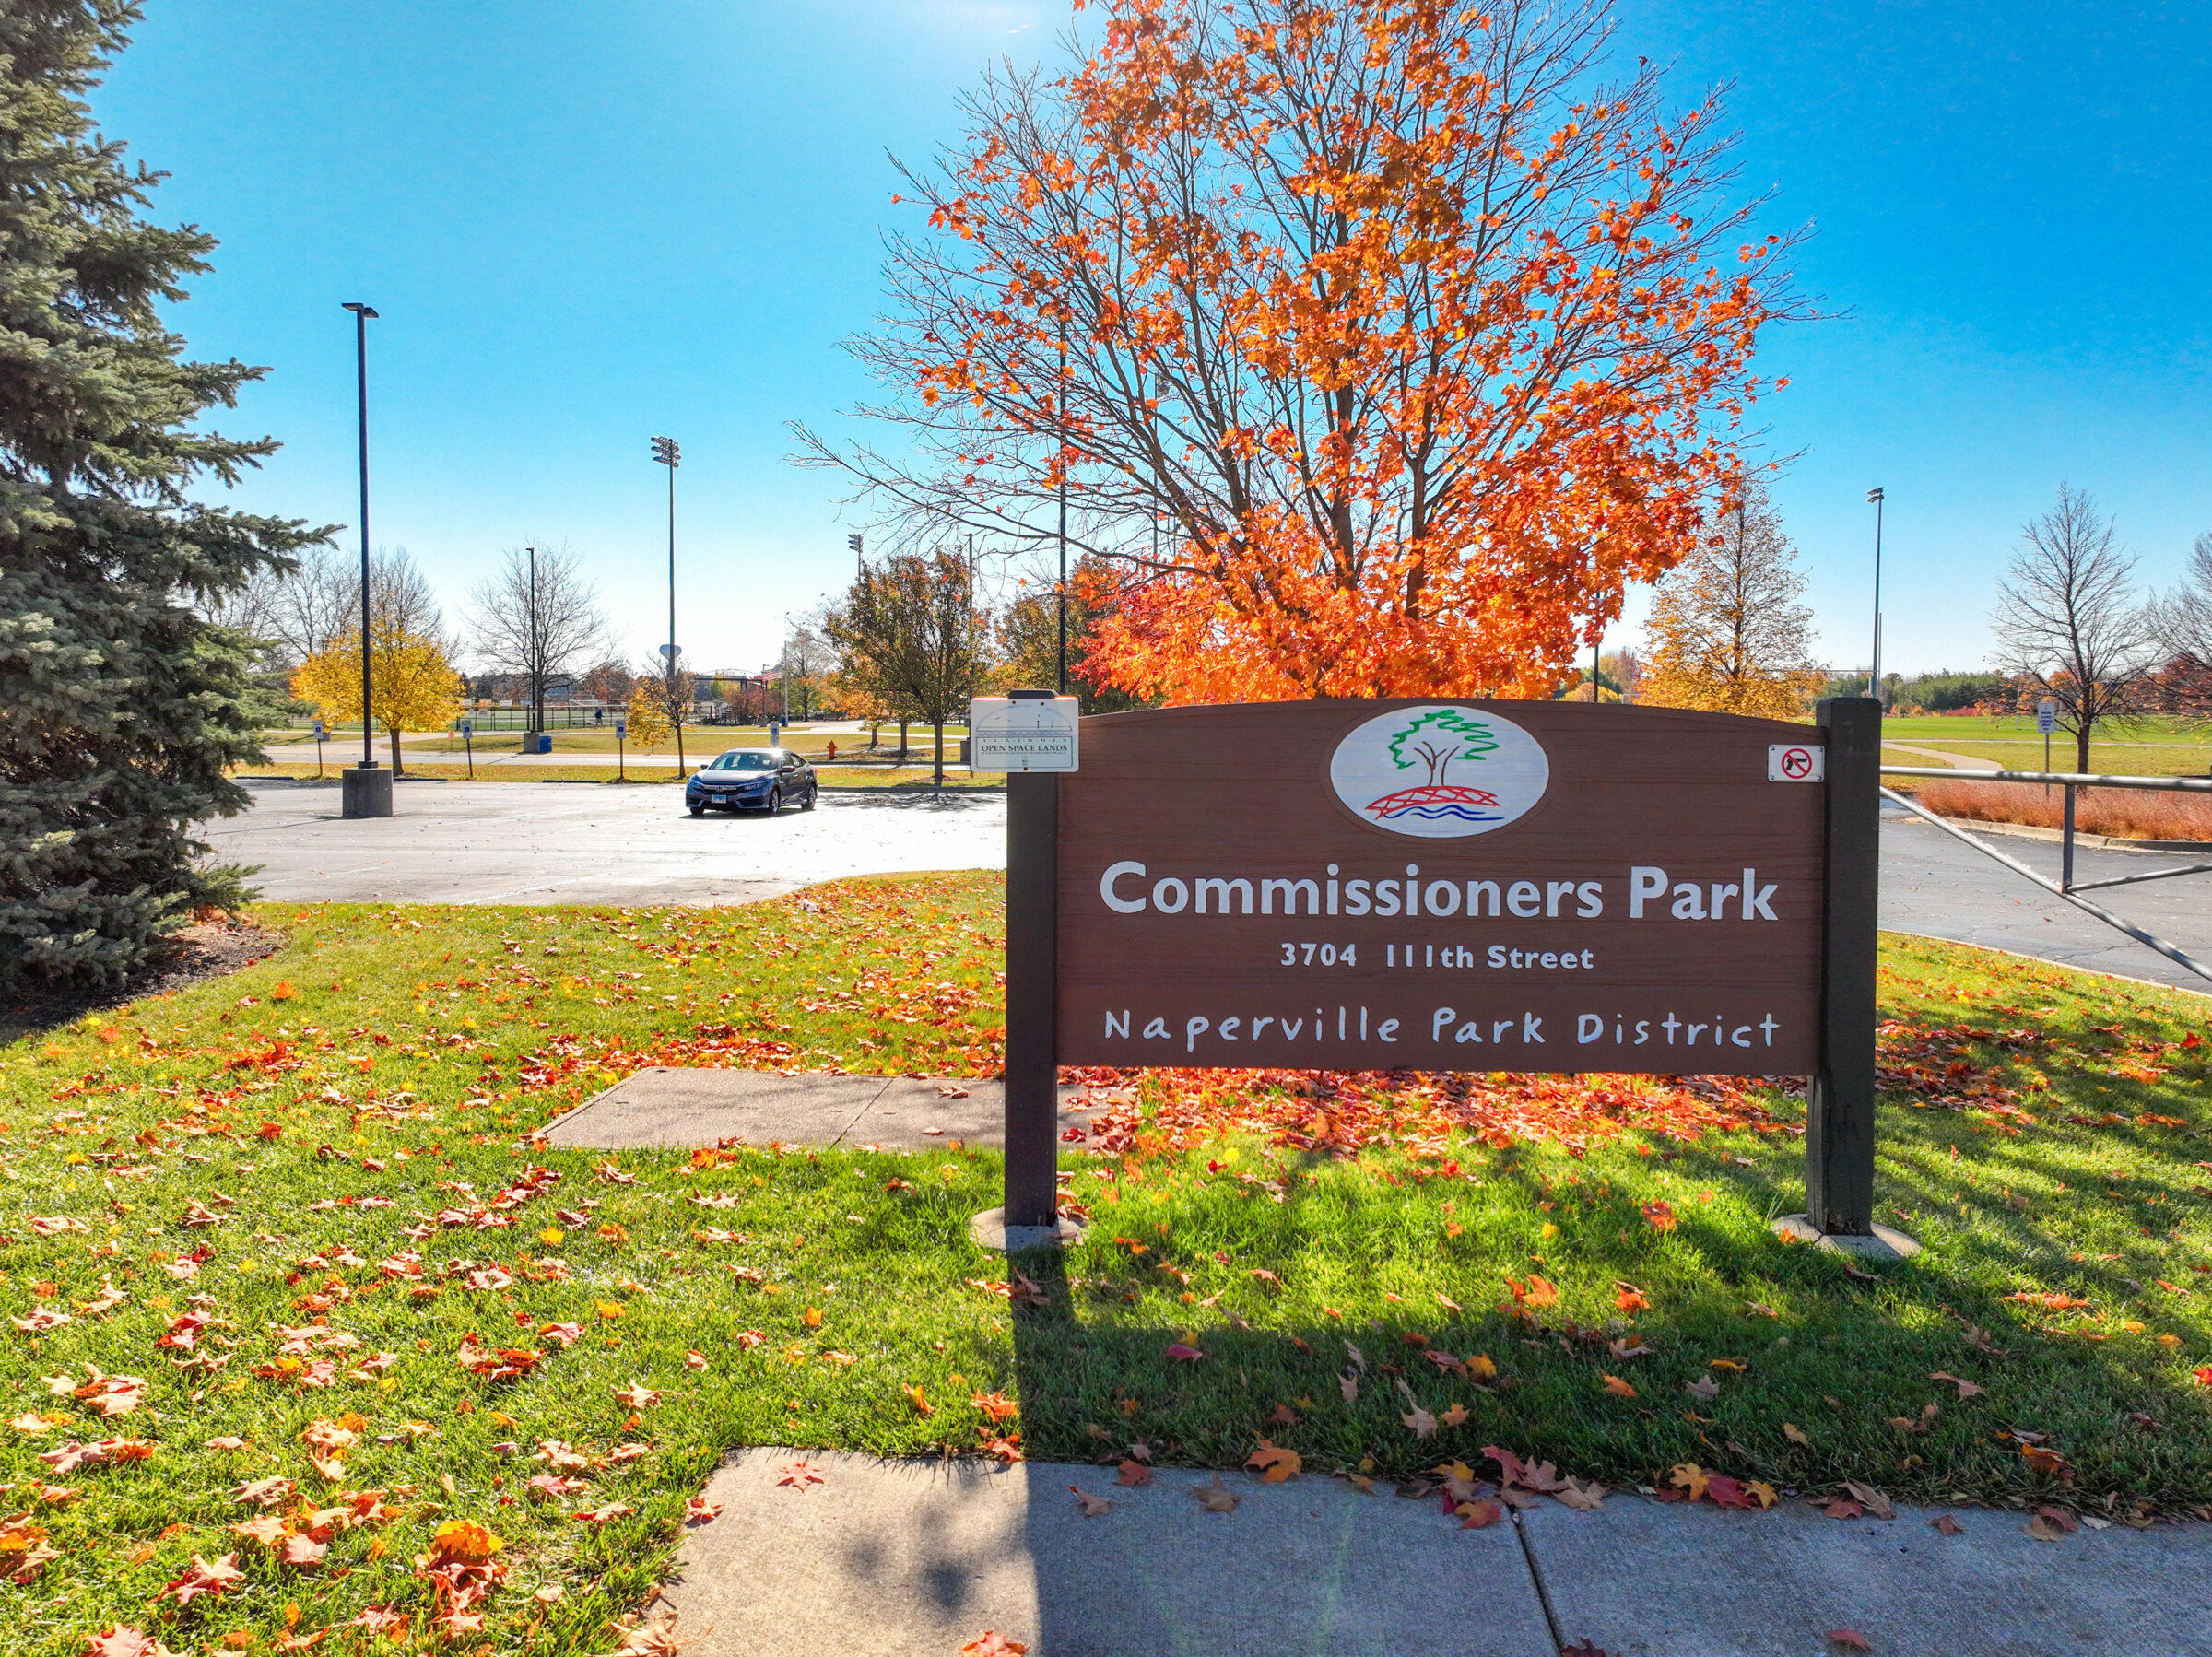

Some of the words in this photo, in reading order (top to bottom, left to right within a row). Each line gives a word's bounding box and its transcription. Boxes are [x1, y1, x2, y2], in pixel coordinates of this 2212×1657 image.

[1100, 860, 1604, 918] Commissioners
[1629, 866, 1779, 921] Park
[1280, 942, 1357, 967] 3704
[1386, 944, 1474, 968] 111th
[1488, 945, 1594, 970] Street
[1105, 1006, 1400, 1052] Naperville
[1432, 1007, 1547, 1045] Park
[1577, 1011, 1781, 1049] District
